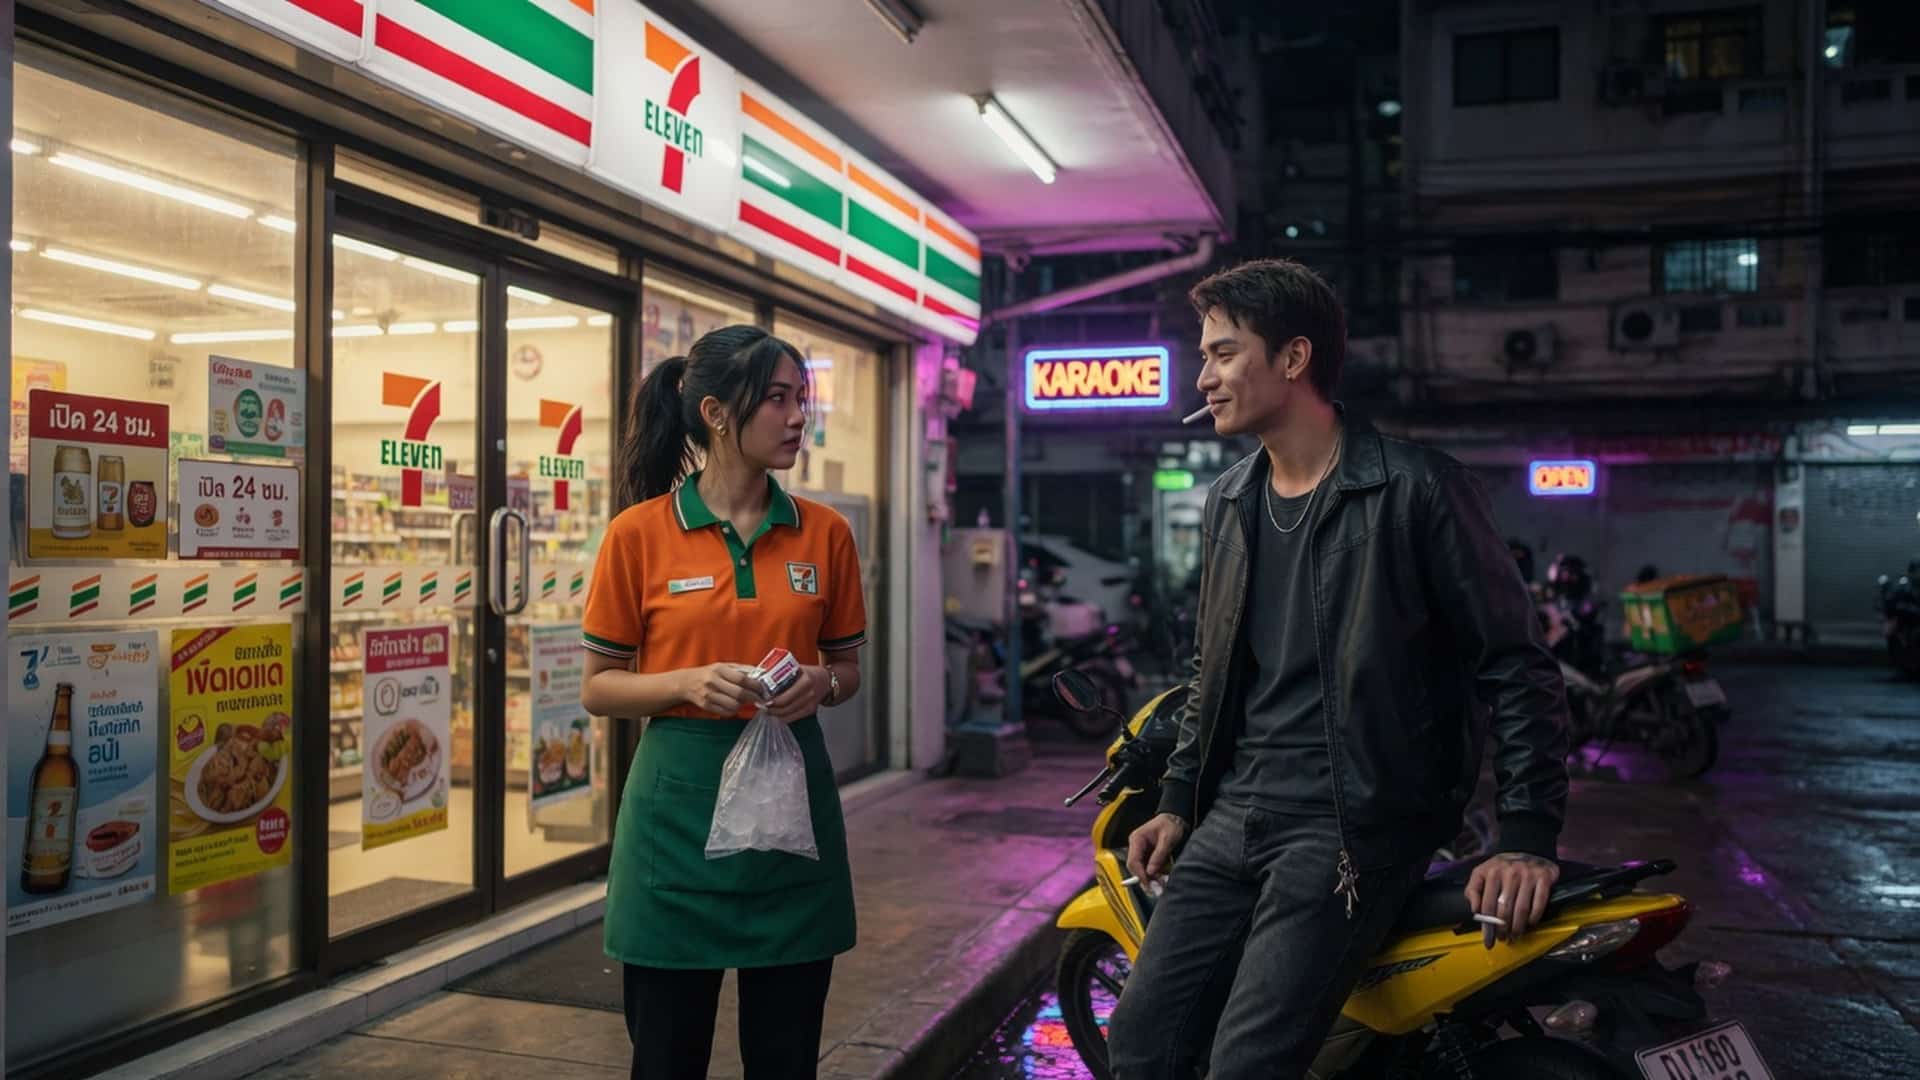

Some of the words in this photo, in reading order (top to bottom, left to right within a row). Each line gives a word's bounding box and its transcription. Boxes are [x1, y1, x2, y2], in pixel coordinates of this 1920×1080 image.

[644, 21, 701, 194] 7
[644, 99, 703, 158] ELEVEN
[1033, 358, 1160, 397] KARAOKE
[49, 404, 87, 430] เปิด
[93, 409, 119, 433] 24
[381, 439, 442, 471] ELEVEN
[382, 372, 441, 507] 7
[538, 398, 583, 511] 7
[539, 456, 584, 479] ELEVEN
[1534, 466, 1590, 490] OPEN
[232, 475, 256, 500] 24
